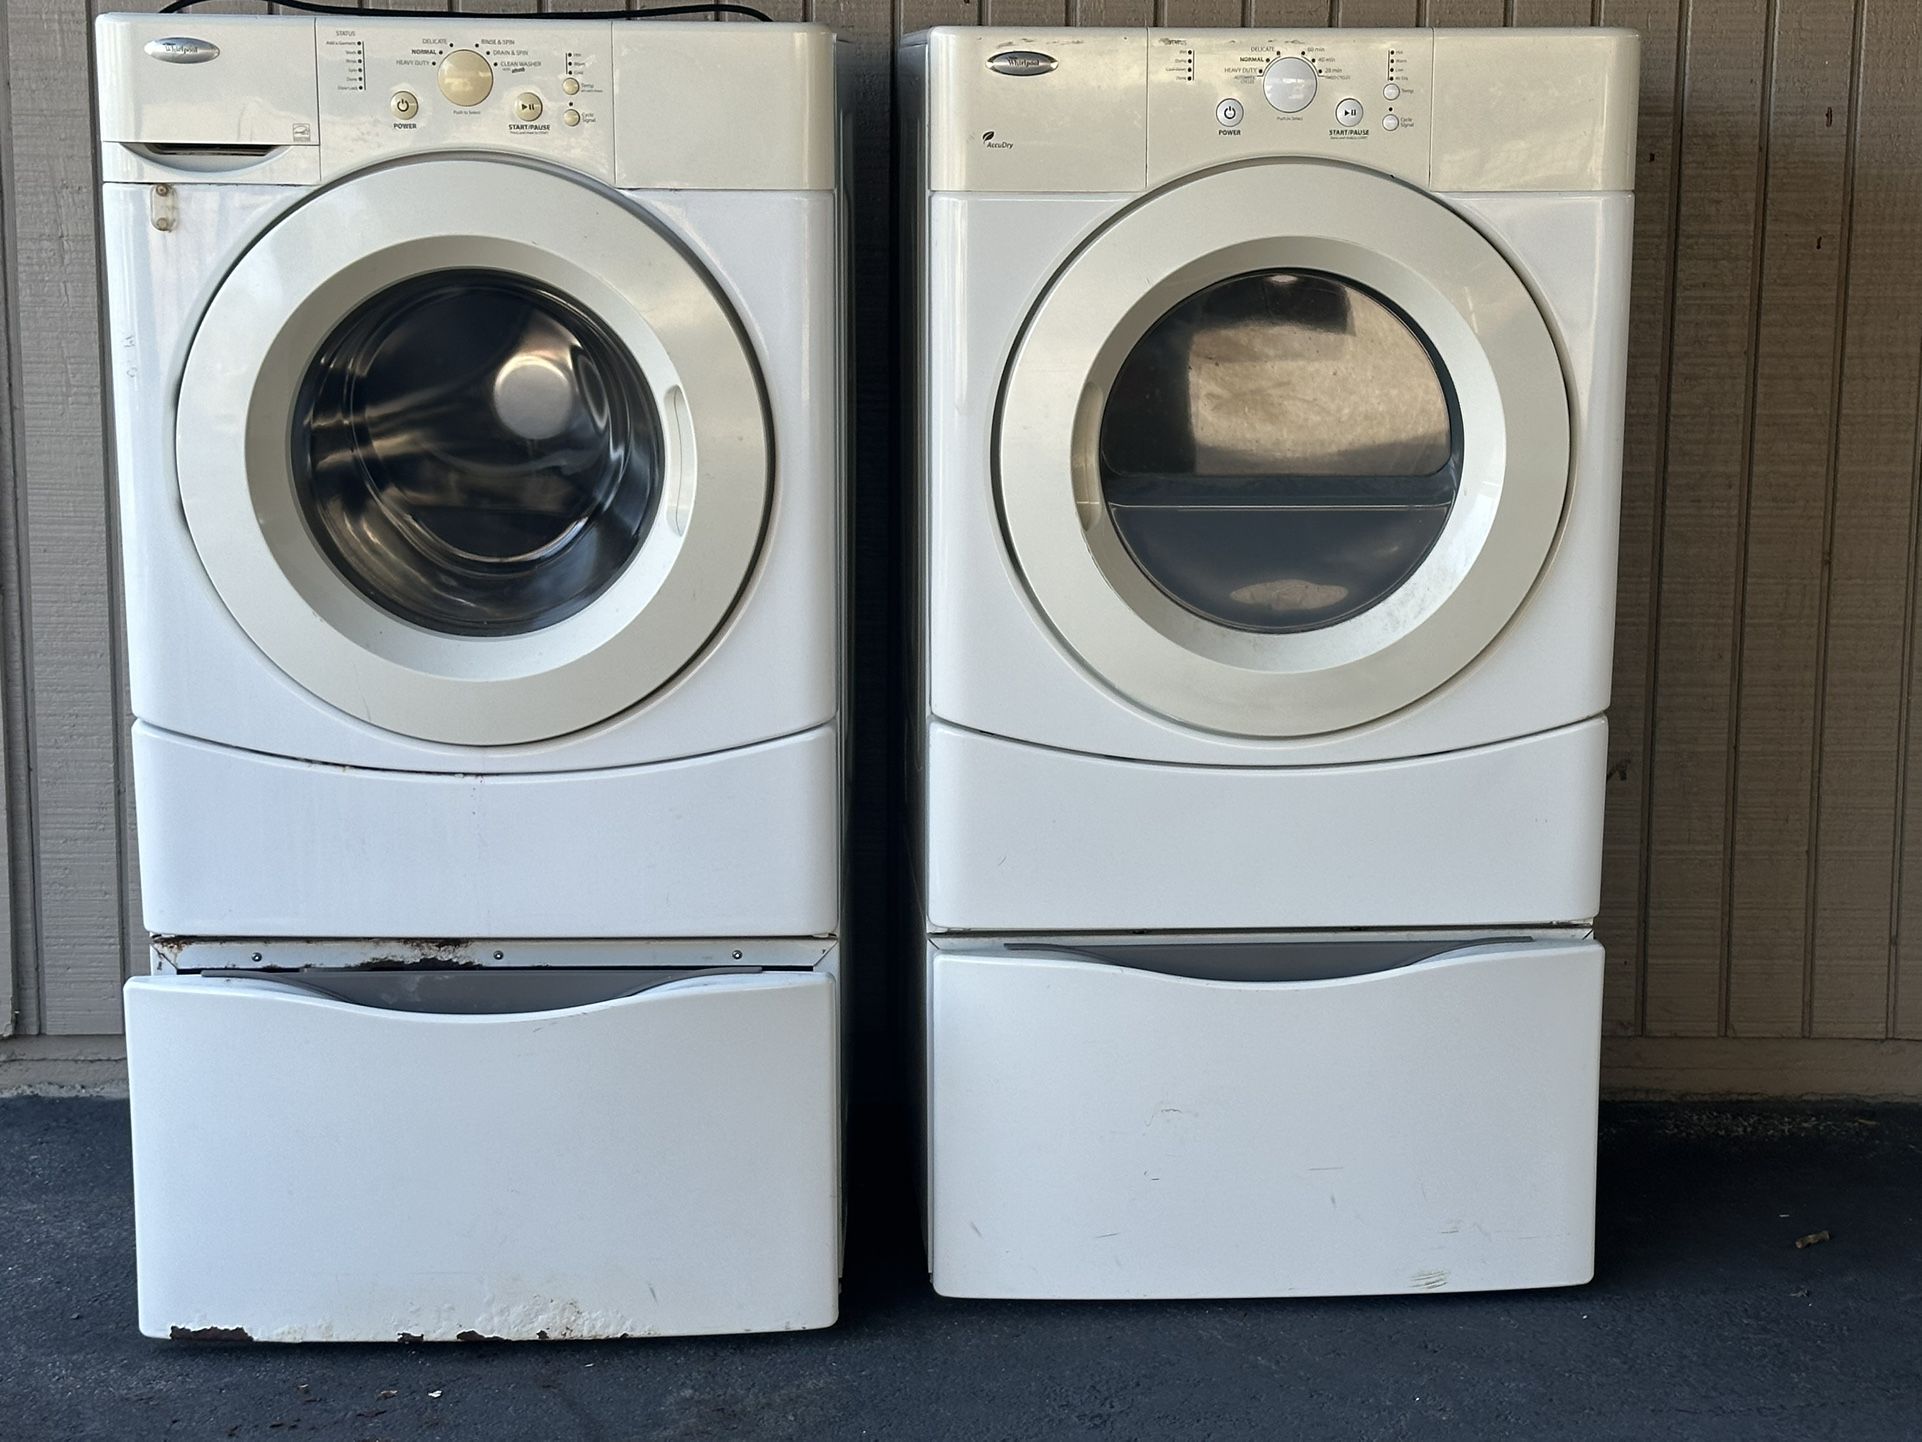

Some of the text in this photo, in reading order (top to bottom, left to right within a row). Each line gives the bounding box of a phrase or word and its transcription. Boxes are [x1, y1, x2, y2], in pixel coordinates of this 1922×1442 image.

[164, 44, 198, 54] Whirlpool
[1008, 58, 1040, 67] Whirlpool
[986, 141, 1014, 149] AccuDry
